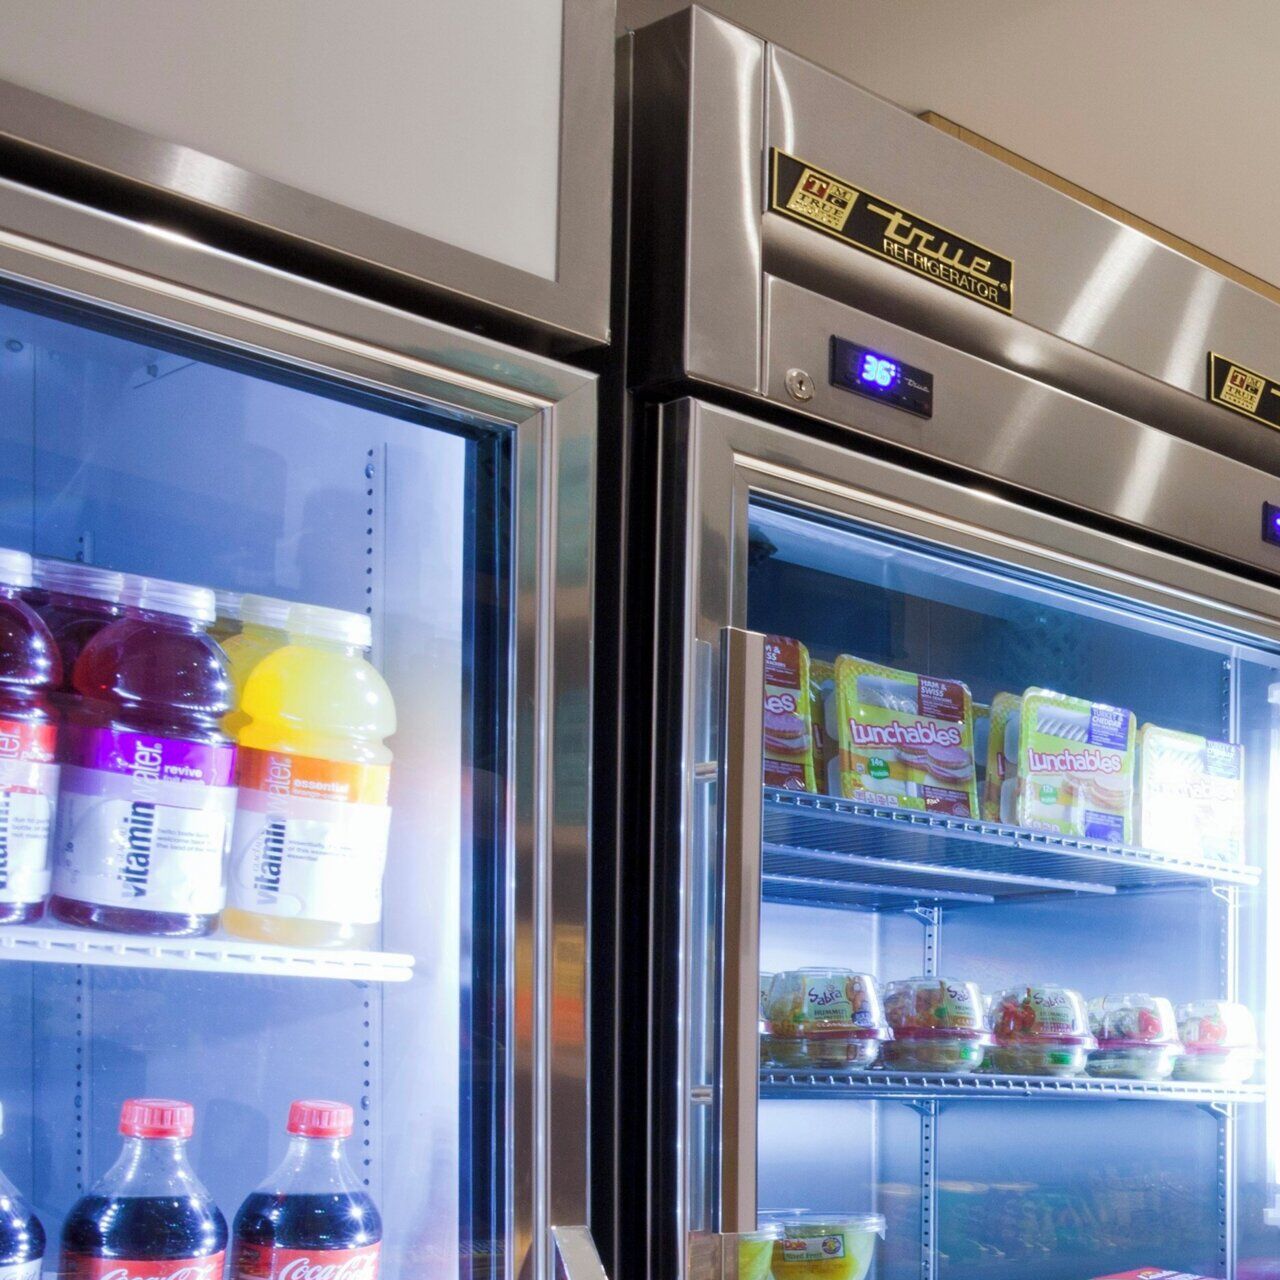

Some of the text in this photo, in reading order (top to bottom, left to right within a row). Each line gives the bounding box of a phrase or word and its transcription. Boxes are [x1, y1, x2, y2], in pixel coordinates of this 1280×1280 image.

[798, 193, 845, 218] TRUE
[866, 203, 1000, 287] true
[882, 238, 999, 303] REFRIGERATOR
[1227, 385, 1257, 402] TRUE
[849, 717, 962, 747] Lunchables
[164, 764, 203, 779] revive
[1028, 748, 1123, 774] Lunchables
[807, 985, 844, 1007] Sabra
